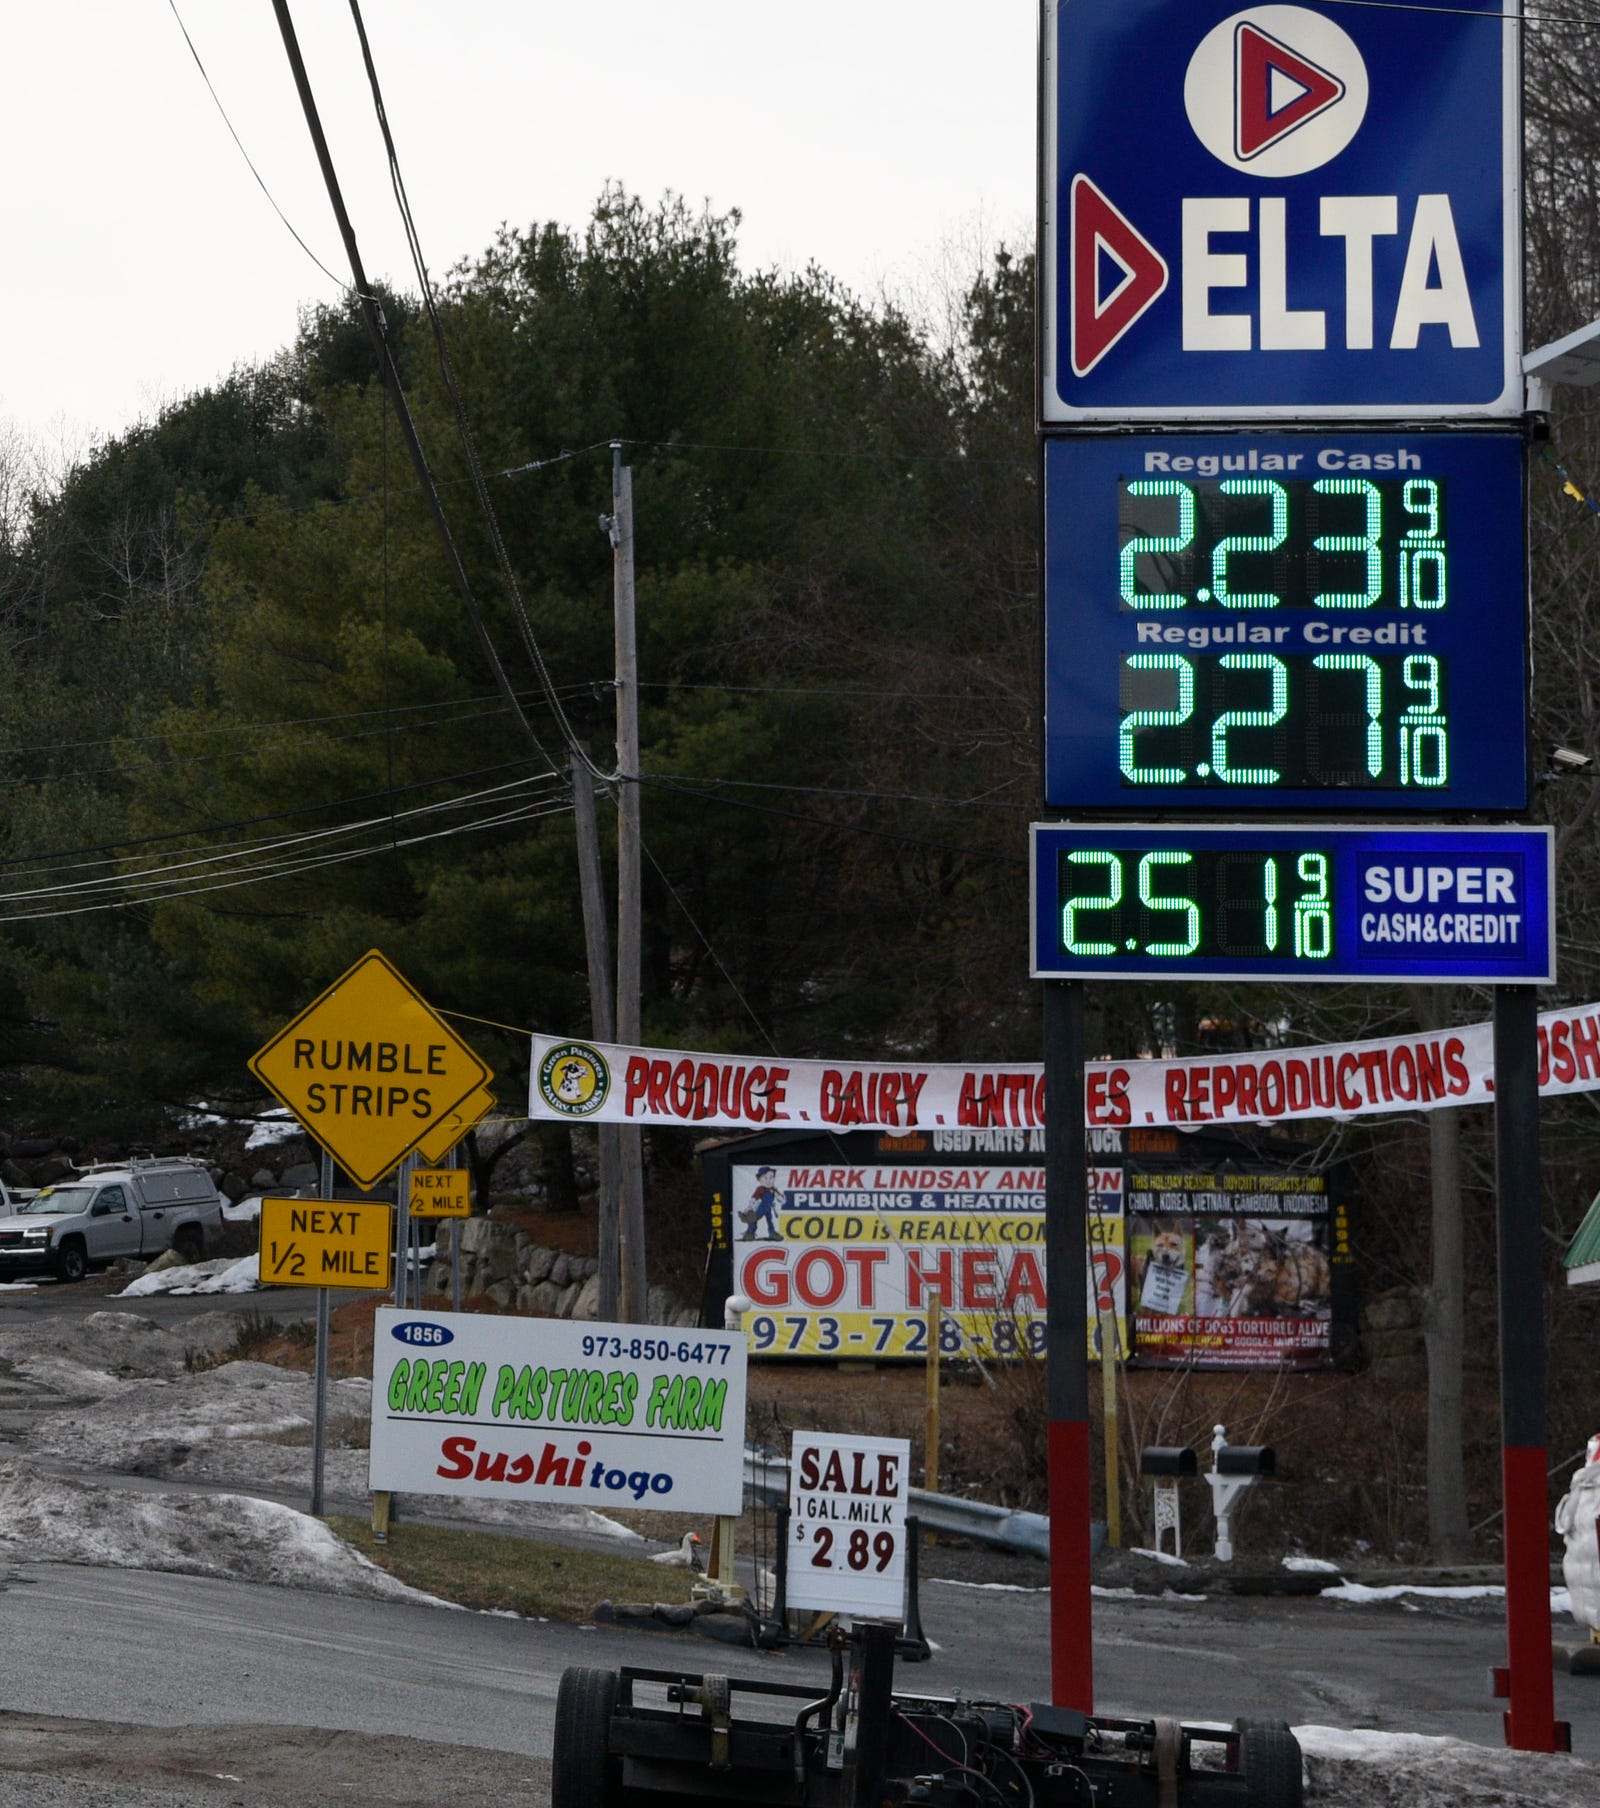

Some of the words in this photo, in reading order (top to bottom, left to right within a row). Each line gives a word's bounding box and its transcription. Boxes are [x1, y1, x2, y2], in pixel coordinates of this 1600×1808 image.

[1144, 450, 1303, 475] Regular
[1317, 449, 1422, 471] Cash
[1137, 622, 1290, 647] Regular
[1302, 621, 1428, 645] Credit
[1364, 866, 1518, 904] SUPER
[1360, 912, 1522, 945] CASH&CREDIT
[293, 1038, 447, 1076] RUMBLE
[543, 1049, 568, 1073] Green
[570, 1046, 604, 1078] Pastures
[625, 1055, 791, 1121] PRODUCE
[820, 1069, 929, 1127] DAIRY
[957, 1068, 1131, 1128] ANTIES
[1164, 1037, 1470, 1122] REPRODUCTIONS
[306, 1083, 433, 1119] STRIPS
[543, 1084, 571, 1111] DAIRY
[572, 1089, 604, 1113] FARMS
[933, 1130, 973, 1152] USED
[974, 1130, 1025, 1152] PARTS
[414, 1175, 453, 1189] NEXT
[787, 1169, 868, 1189] MARK
[873, 1169, 990, 1190] LINDSAY
[432, 1196, 465, 1209] MILE
[793, 1193, 912, 1208] PLUMBING
[920, 1194, 936, 1208] &
[944, 1194, 1046, 1209] HEATING
[290, 1209, 361, 1236] NEXT
[786, 1216, 864, 1240] COLD
[872, 1219, 891, 1240] is
[899, 1220, 992, 1241] REALLY
[321, 1250, 380, 1276] MILE
[741, 1247, 888, 1309] GOT
[1135, 1318, 1185, 1333] MILLIONS
[1237, 1320, 1295, 1335] TORTURED
[1299, 1321, 1330, 1336] ALIVE
[403, 1326, 443, 1345] 1856
[581, 1335, 731, 1366] 973-850-6477
[387, 1358, 487, 1415] GREEN
[492, 1364, 639, 1427] PASTURES
[645, 1374, 729, 1432] FARM
[436, 1436, 593, 1488] Sushi
[590, 1461, 674, 1500] togo
[800, 1447, 900, 1498] SALE
[796, 1523, 805, 1543] $
